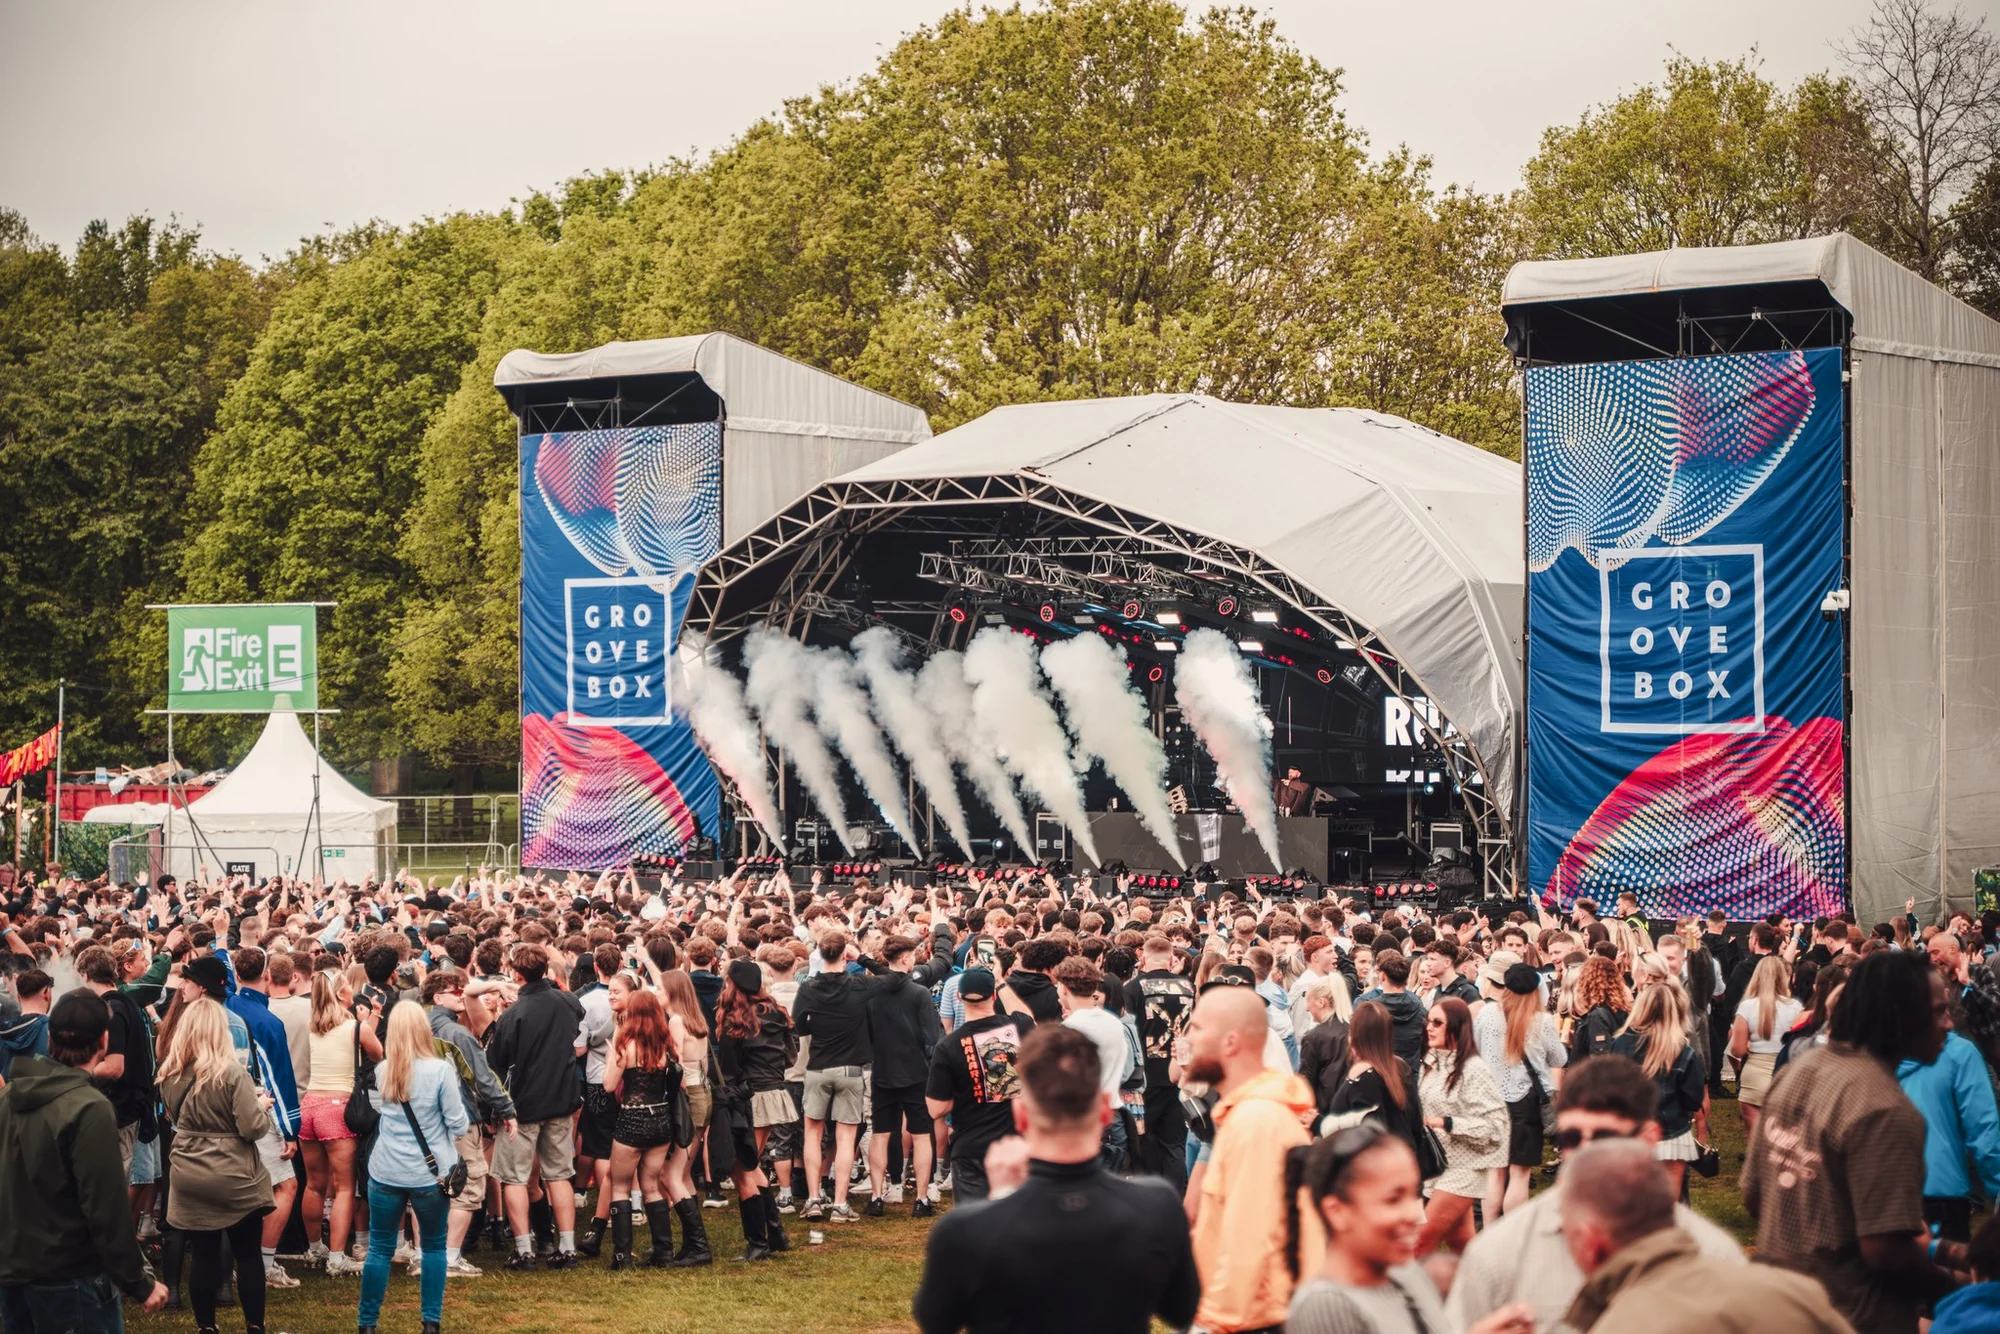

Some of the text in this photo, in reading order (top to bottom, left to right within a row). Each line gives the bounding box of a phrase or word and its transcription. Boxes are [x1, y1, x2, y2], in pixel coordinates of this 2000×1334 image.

[1631, 580, 1731, 610] GRO
[584, 603, 651, 628] GRO
[215, 627, 263, 658] Fire
[585, 640, 649, 664] OVE
[1629, 625, 1728, 655] OVE
[273, 644, 297, 677] E
[215, 660, 264, 691] Exit
[587, 675, 651, 699] BOX
[1634, 670, 1731, 699] BOX
[231, 864, 250, 873] GATE
